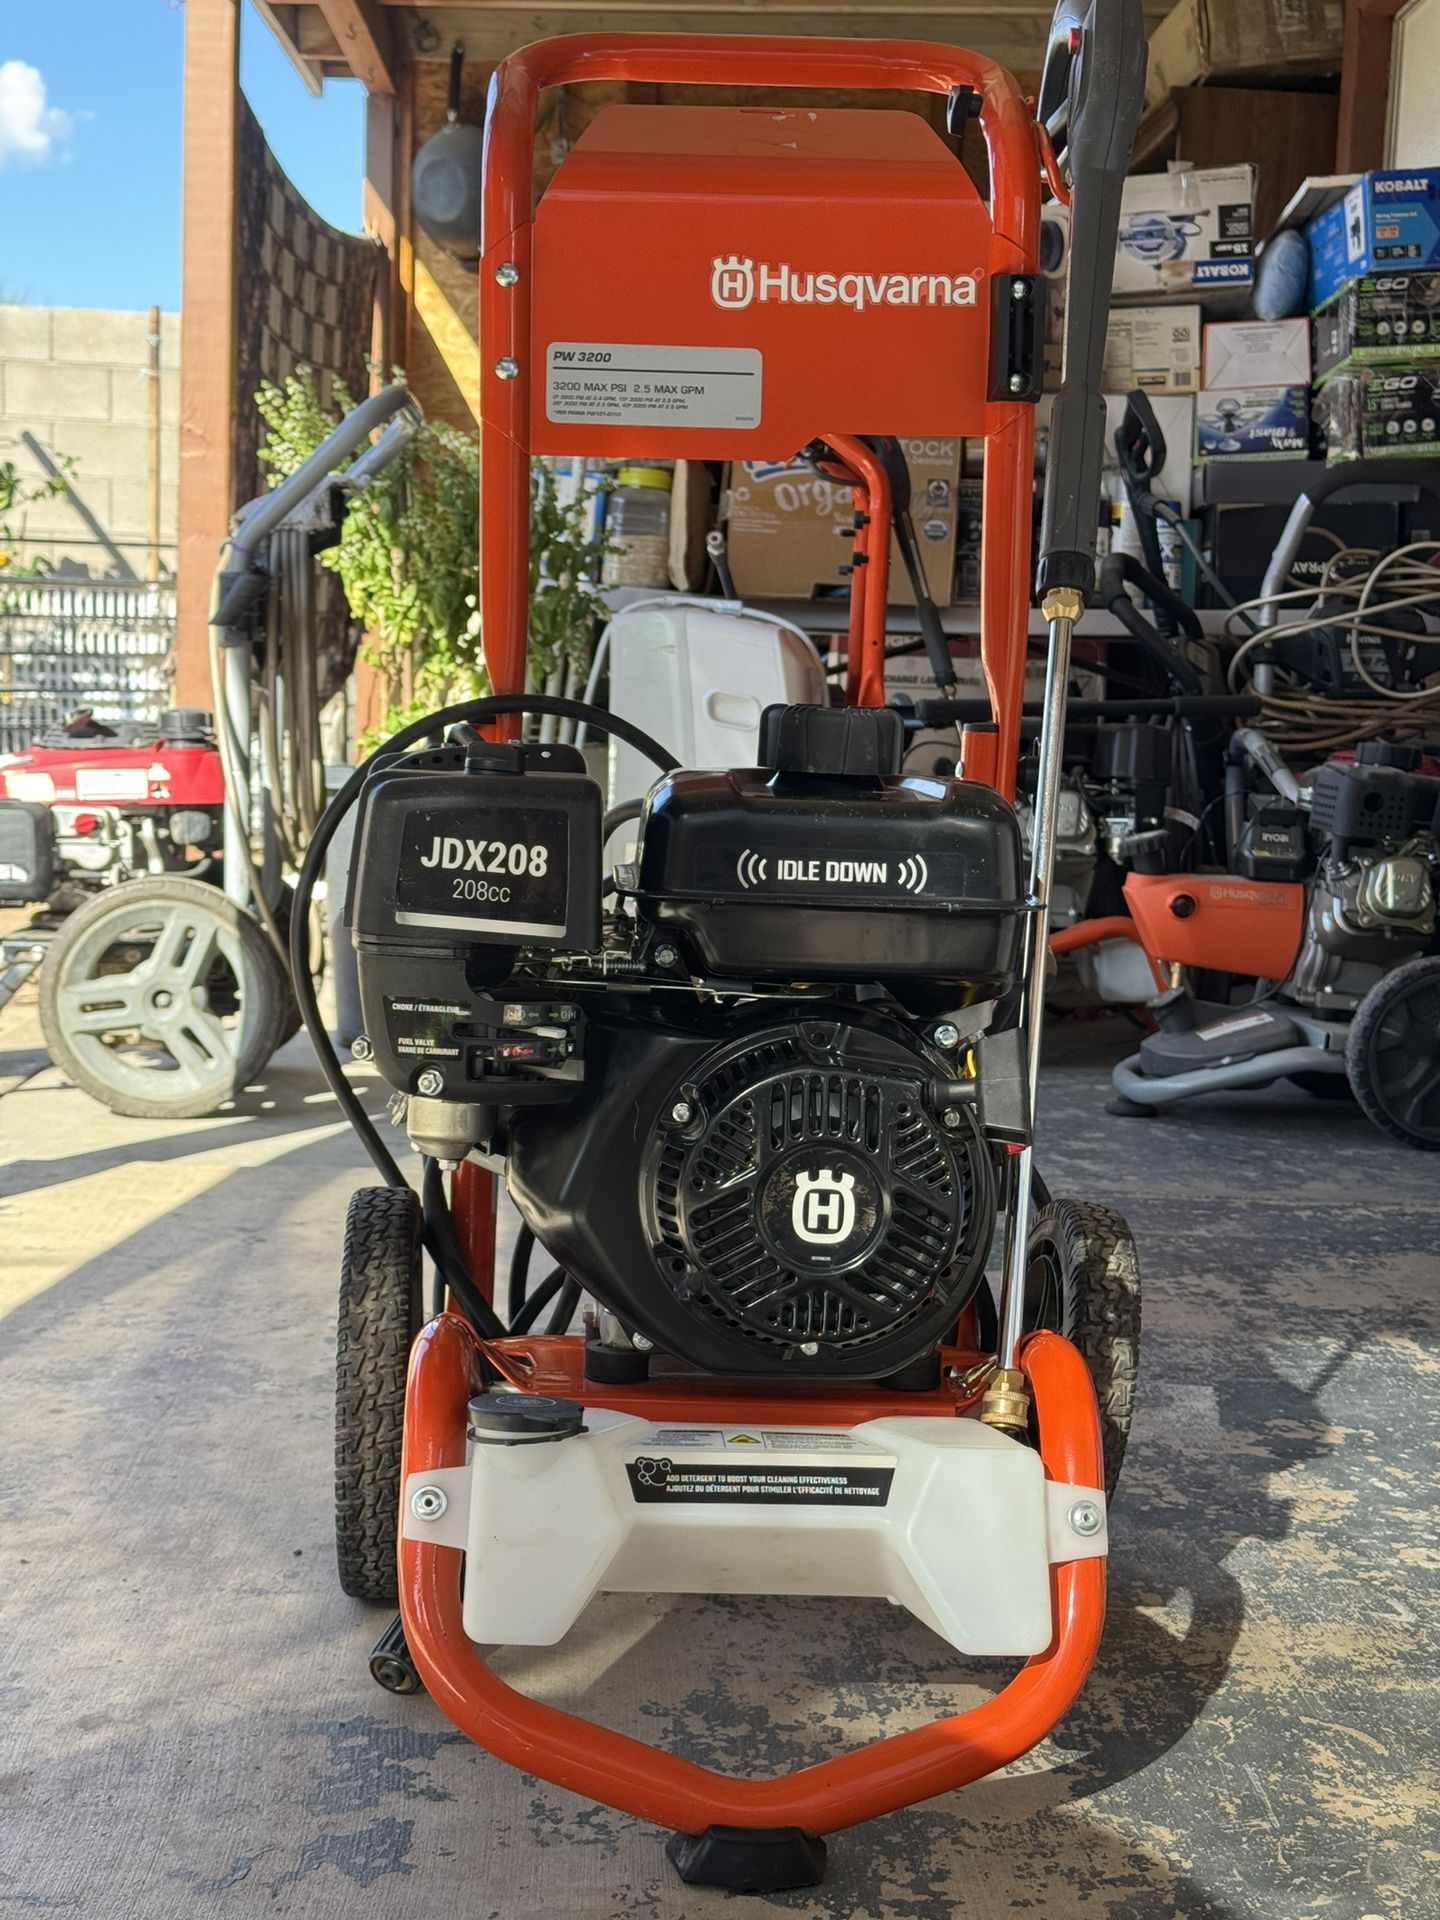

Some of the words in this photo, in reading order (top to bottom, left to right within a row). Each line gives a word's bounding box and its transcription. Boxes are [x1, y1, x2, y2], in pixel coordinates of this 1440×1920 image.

[1375, 179, 1428, 193] KOBALT
[1196, 264, 1250, 278] KOBALT
[759, 264, 975, 310] Husqvarna
[553, 351, 575, 362] PW
[578, 352, 612, 363] 3200
[553, 382, 581, 391] 3200
[584, 382, 608, 392] MAX
[610, 383, 627, 392] PSI
[633, 384, 650, 393] 2.5
[654, 385, 678, 394] MAX
[680, 386, 705, 395] GPM
[898, 439, 953, 456] TOCK
[773, 480, 853, 516] Orga
[1292, 562, 1335, 573] PRAY
[1261, 832, 1289, 843] RYOBI
[420, 836, 548, 877] JDX208
[777, 860, 820, 881] IDLE
[825, 861, 887, 883] DOWN
[452, 878, 511, 903] 208cc
[392, 1003, 414, 1011] CHOKE
[398, 1038, 414, 1046] FUEL
[414, 1038, 435, 1046] VALVE
[425, 1047, 460, 1056] CARBURANT
[767, 1476, 798, 1484] CLEANING
[799, 1477, 848, 1485] EFFECTIVENESS
[705, 1484, 741, 1493] DÉTERGENT
[760, 1486, 792, 1494] STIMULER
[792, 1485, 833, 1494] L'EFFICACITÉ
[844, 1487, 880, 1495] NETTOYAGE
